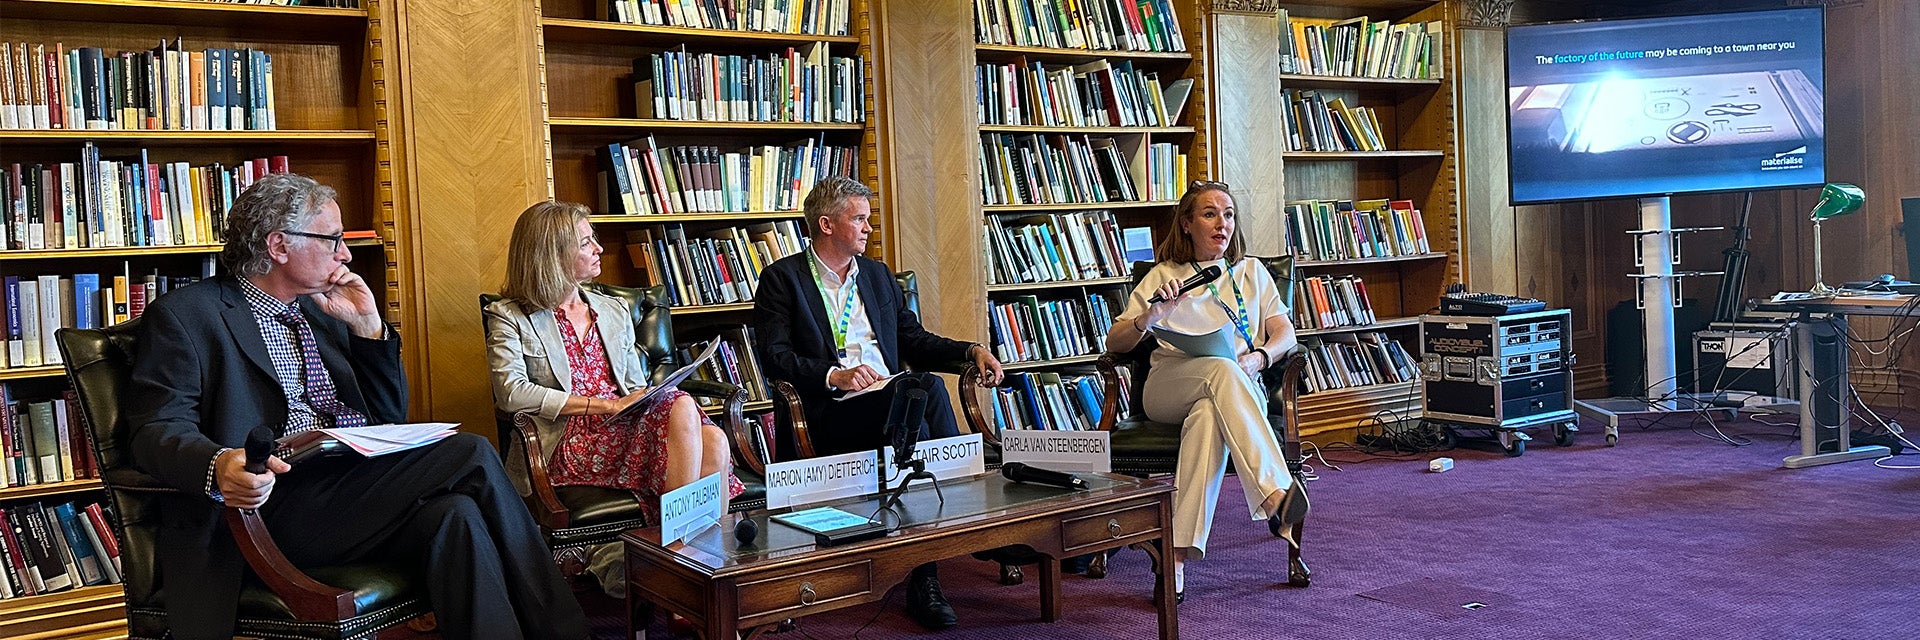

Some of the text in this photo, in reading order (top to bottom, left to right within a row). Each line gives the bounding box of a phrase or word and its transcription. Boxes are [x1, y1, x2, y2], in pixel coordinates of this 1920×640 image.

[1536, 56, 1553, 64] The
[1554, 54, 1587, 63] factory
[1588, 52, 1598, 61] of
[1600, 52, 1614, 60] the
[1616, 50, 1644, 59] future
[1645, 50, 1665, 58] may
[1667, 48, 1678, 56] be
[1679, 46, 1712, 55] coming
[1713, 45, 1723, 53] to
[1732, 44, 1755, 52] town
[1757, 43, 1777, 51] near
[1778, 42, 1795, 51] you
[1761, 157, 1803, 166] materialise
[1702, 341, 1723, 350] THON
[942, 441, 979, 461] SCOTT
[1004, 437, 1106, 453] CARLA VAN STEENBERGEN
[768, 458, 875, 488] MARION (AMY) DIETTERICH
[665, 481, 719, 522] ANTONY TAUBMAN
